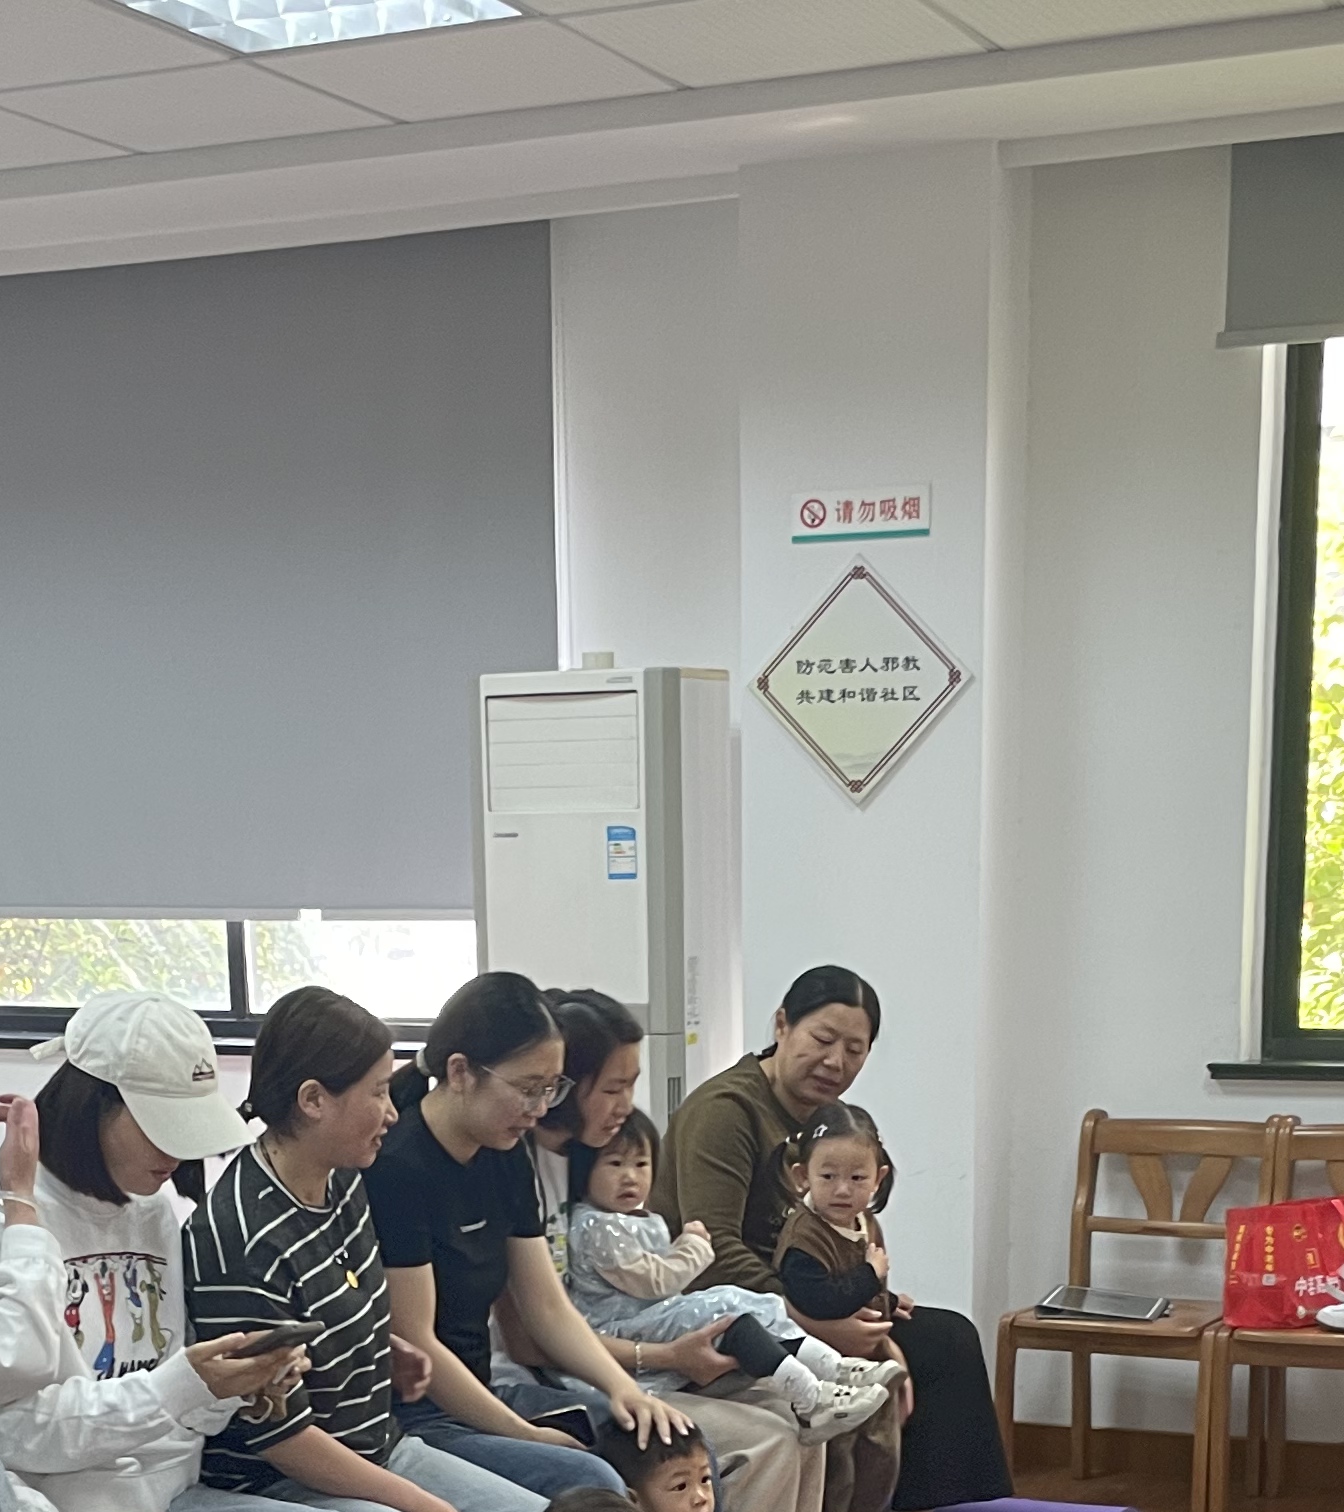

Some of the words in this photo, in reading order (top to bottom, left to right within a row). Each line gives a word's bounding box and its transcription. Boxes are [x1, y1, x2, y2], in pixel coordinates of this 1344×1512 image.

[835, 496, 921, 524] 请勿吸烟
[795, 655, 921, 676] 防范害人邪教
[795, 685, 921, 705] 共建和谐社区
